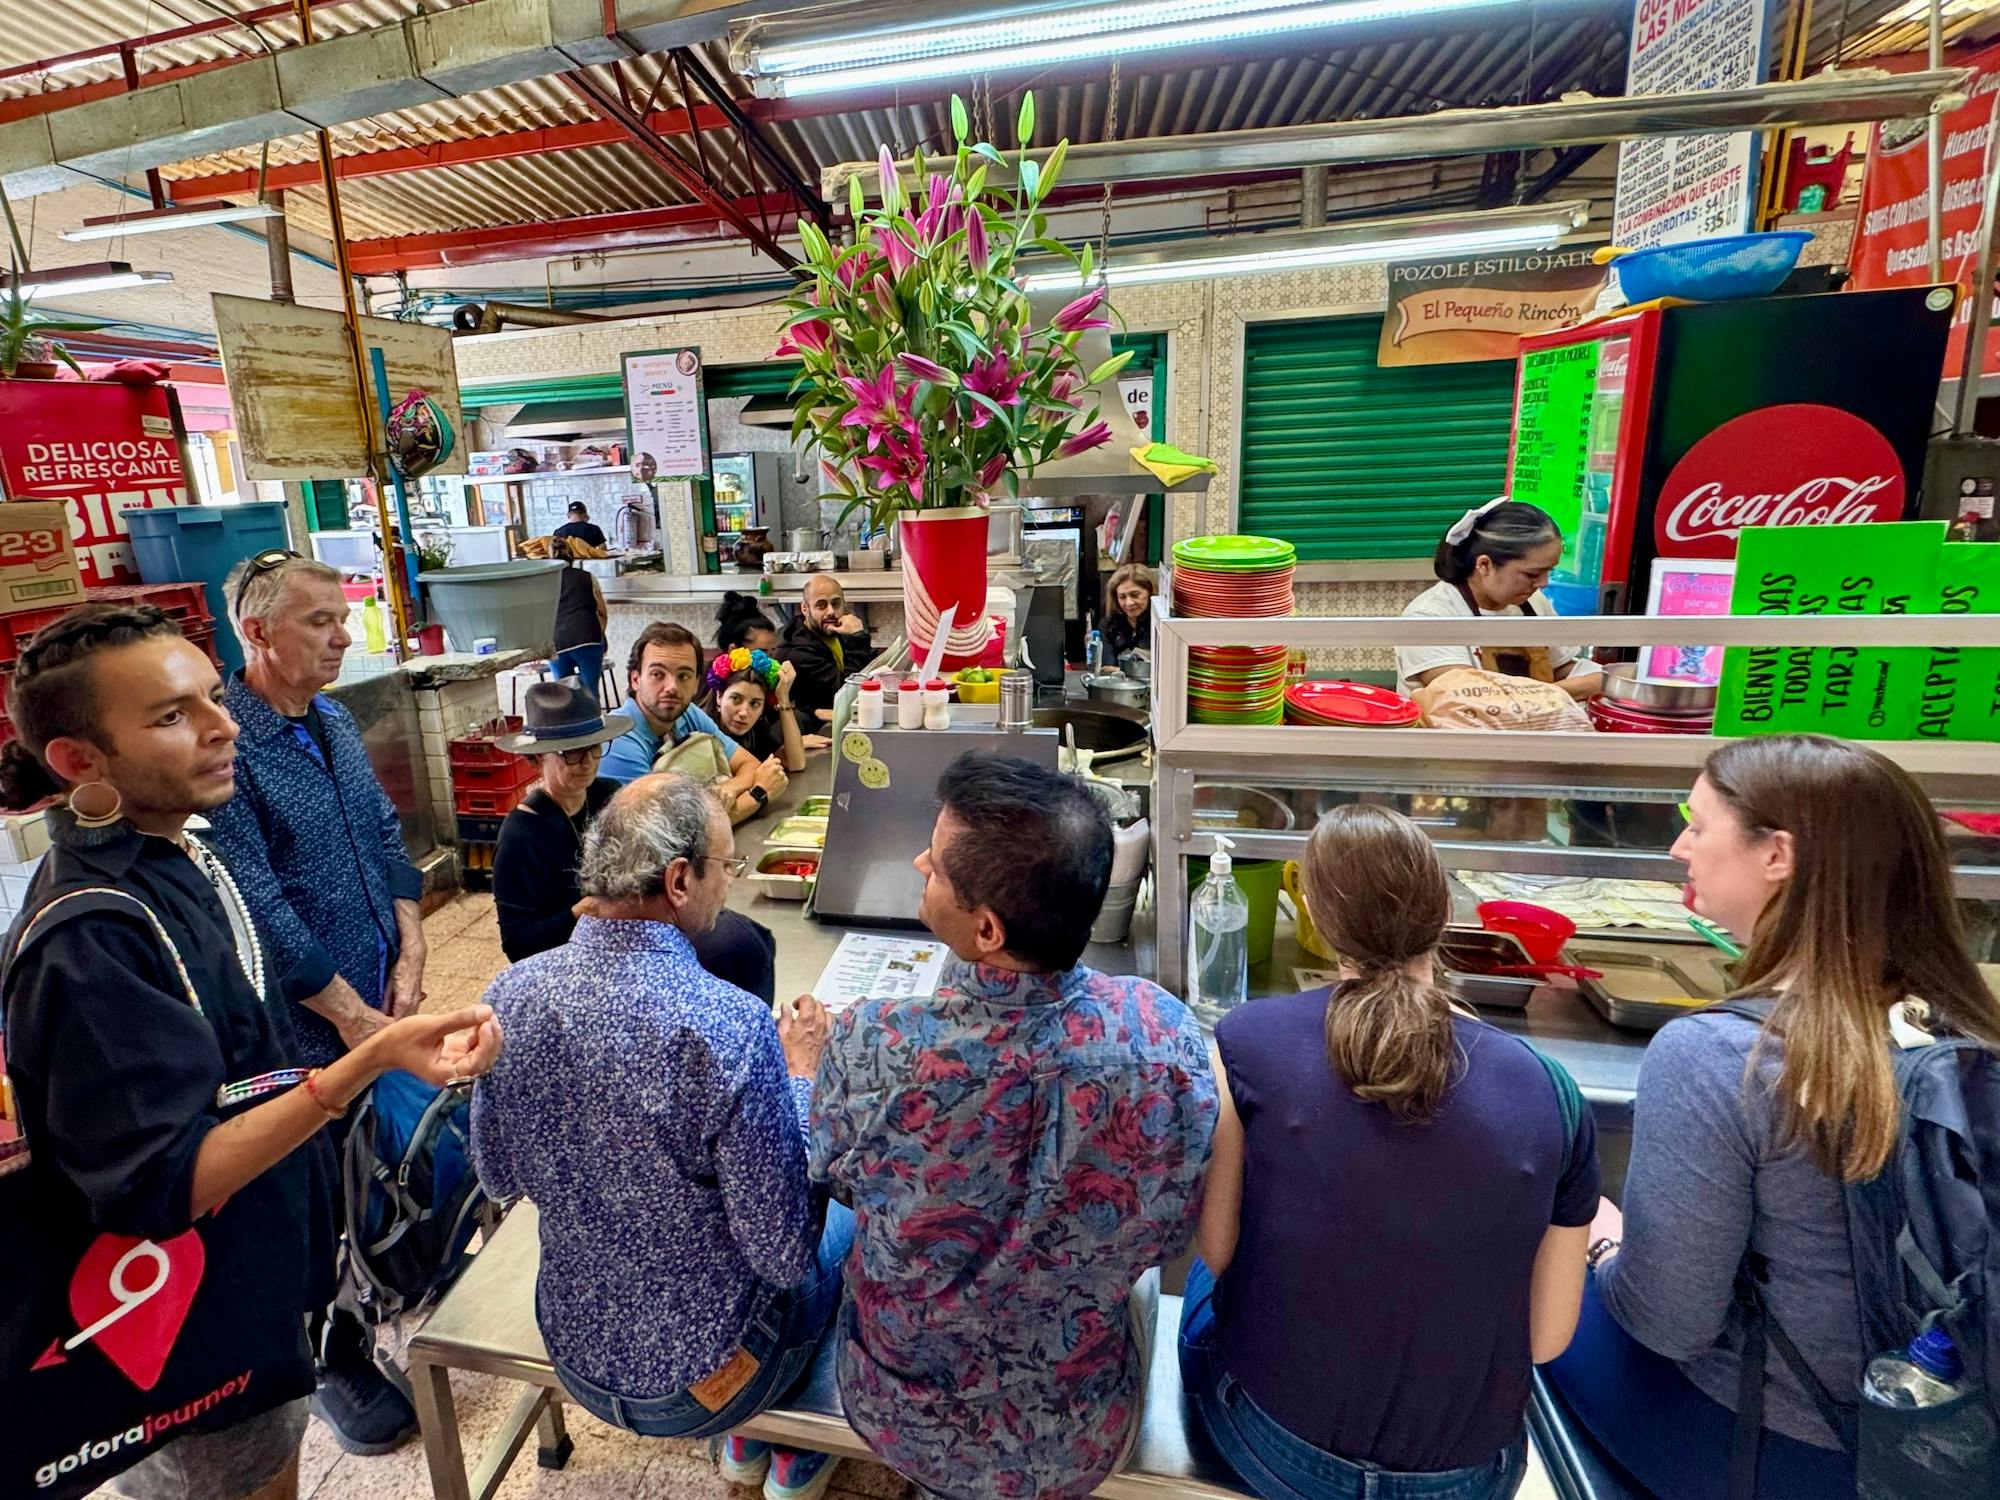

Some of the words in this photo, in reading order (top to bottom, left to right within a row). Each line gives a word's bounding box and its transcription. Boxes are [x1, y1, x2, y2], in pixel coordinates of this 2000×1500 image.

[1637, 11, 1667, 52] LAS
[1672, 0, 1703, 25] ME
[1633, 78, 1653, 96] POLLO
[1659, 54, 1683, 81] JAMON
[1691, 30, 1716, 57] SESOS
[1724, 4, 1753, 34] PANZA
[1633, 28, 1678, 73] QUESADILLAS
[1634, 51, 1673, 85] CHICHARRON
[1679, 26, 1703, 53] CARNE
[1697, 18, 1753, 67] HUITLACOCHE
[1684, 68, 1702, 90] PAPA
[1710, 37, 1750, 71] NOPALES
[1722, 45, 1755, 81] $45.00
[1622, 153, 1640, 171] CARNE
[1675, 139, 1706, 164] NOPALES
[1621, 167, 1637, 184] POLLO
[1674, 159, 1696, 180] PANZA
[1620, 180, 1636, 197] POLLO
[1672, 174, 1694, 193] RAJAS
[1616, 224, 1622, 237] O
[1623, 219, 1632, 234] LA
[1689, 181, 1708, 203] QUE
[1710, 165, 1742, 192] GUSTE
[1643, 227, 1649, 241] Y
[1705, 182, 1740, 214] $40.00
[1889, 201, 1908, 229] con
[1393, 262, 1469, 282] POZOLE
[1474, 256, 1542, 276] ESTILO
[1423, 303, 1439, 320] El
[1445, 301, 1513, 323] Pequeño
[1518, 304, 1581, 321] Rincón
[1127, 388, 1149, 404] de
[27, 441, 169, 464] DELICIOSA
[22, 459, 182, 483] REFRESCANTE
[106, 479, 116, 490] Y
[1665, 474, 1897, 541] Coca-Cola
